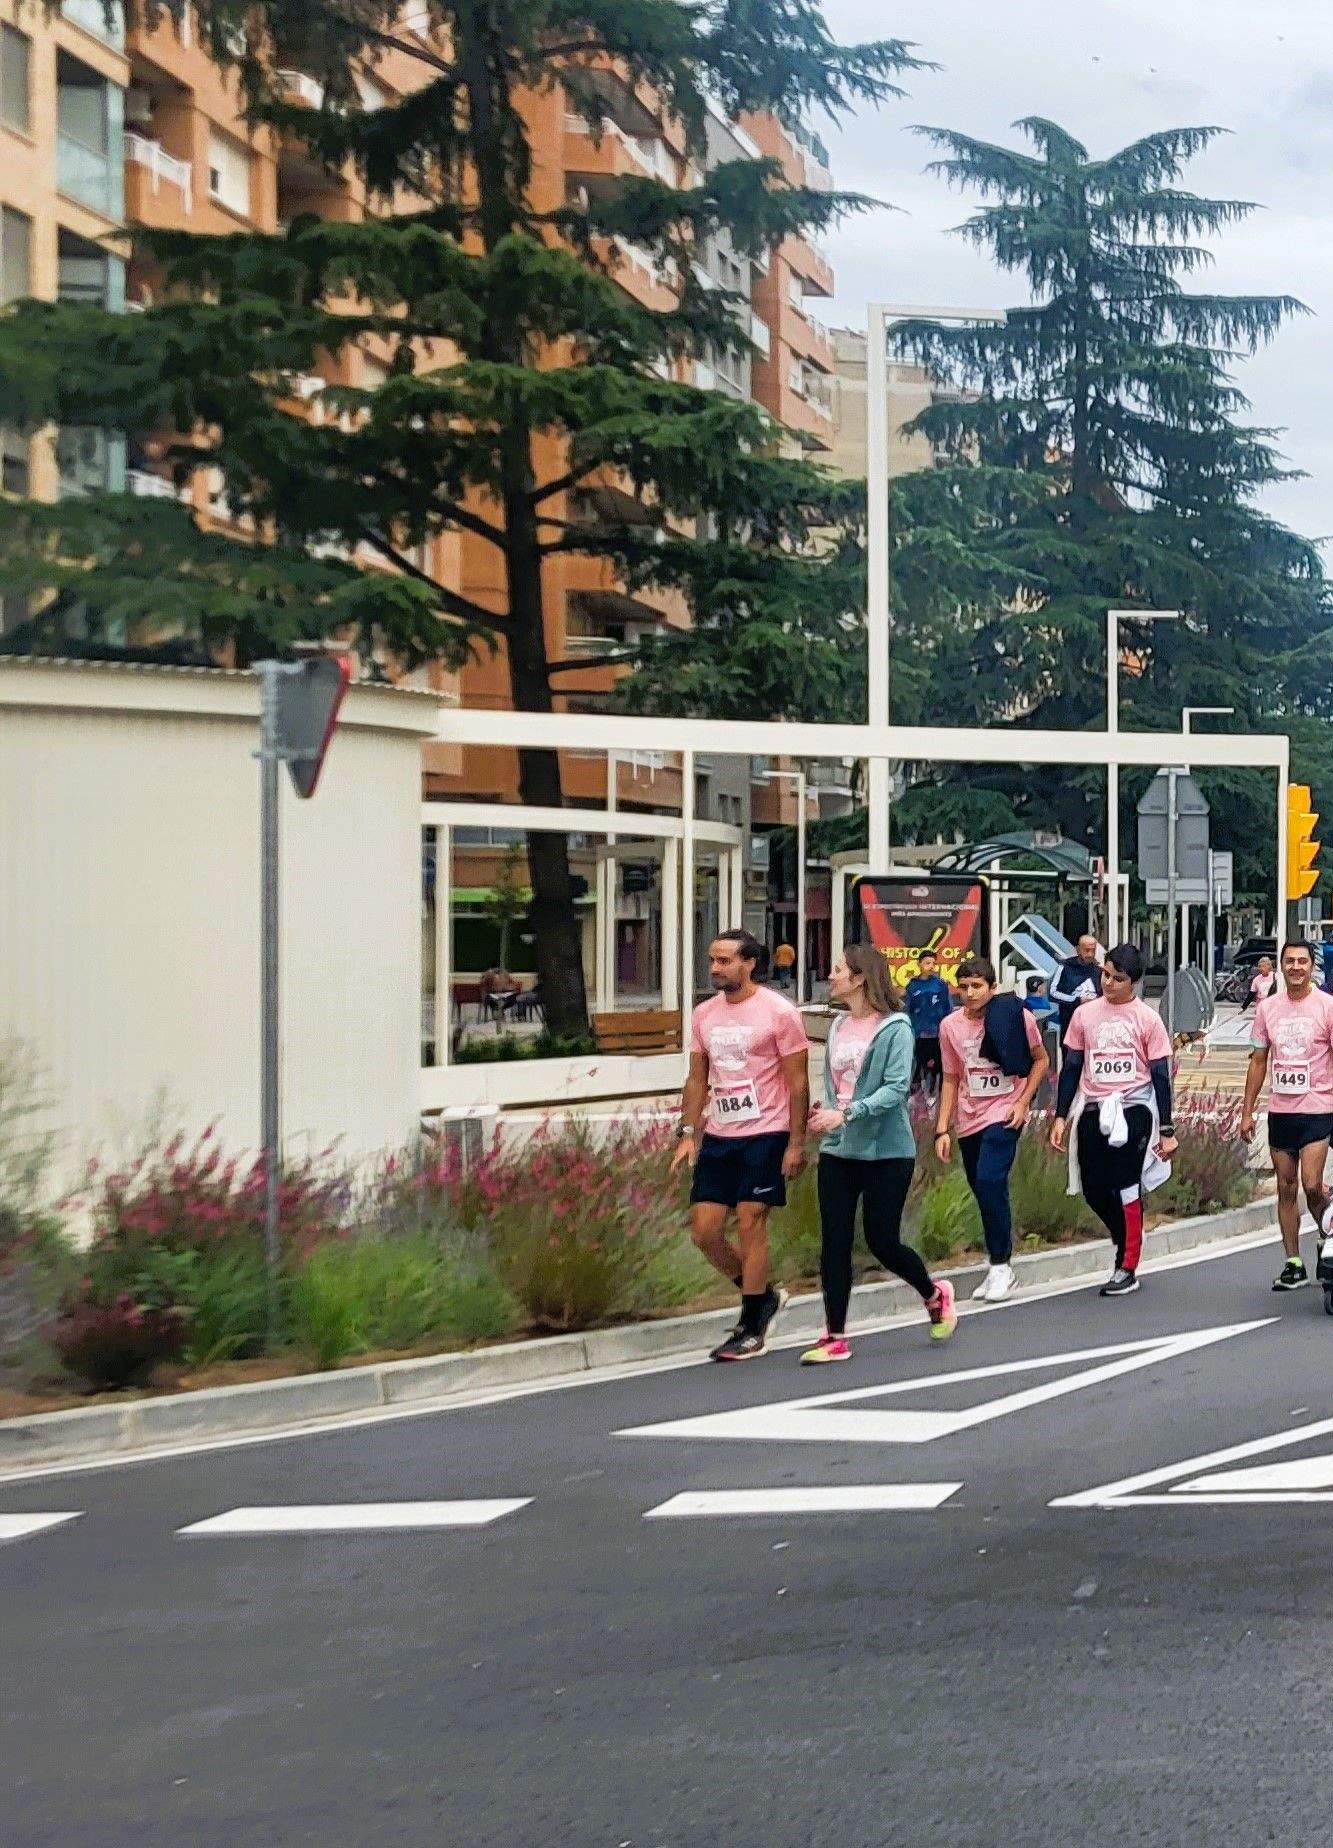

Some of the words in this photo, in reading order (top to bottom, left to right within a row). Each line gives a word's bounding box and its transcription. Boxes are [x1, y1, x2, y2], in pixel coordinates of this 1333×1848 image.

[942, 947, 960, 959] OF
[1094, 1060, 1132, 1074] 2069
[980, 1076, 999, 1089] 70
[1276, 1072, 1306, 1085] 1449
[716, 1094, 753, 1112] 1884
